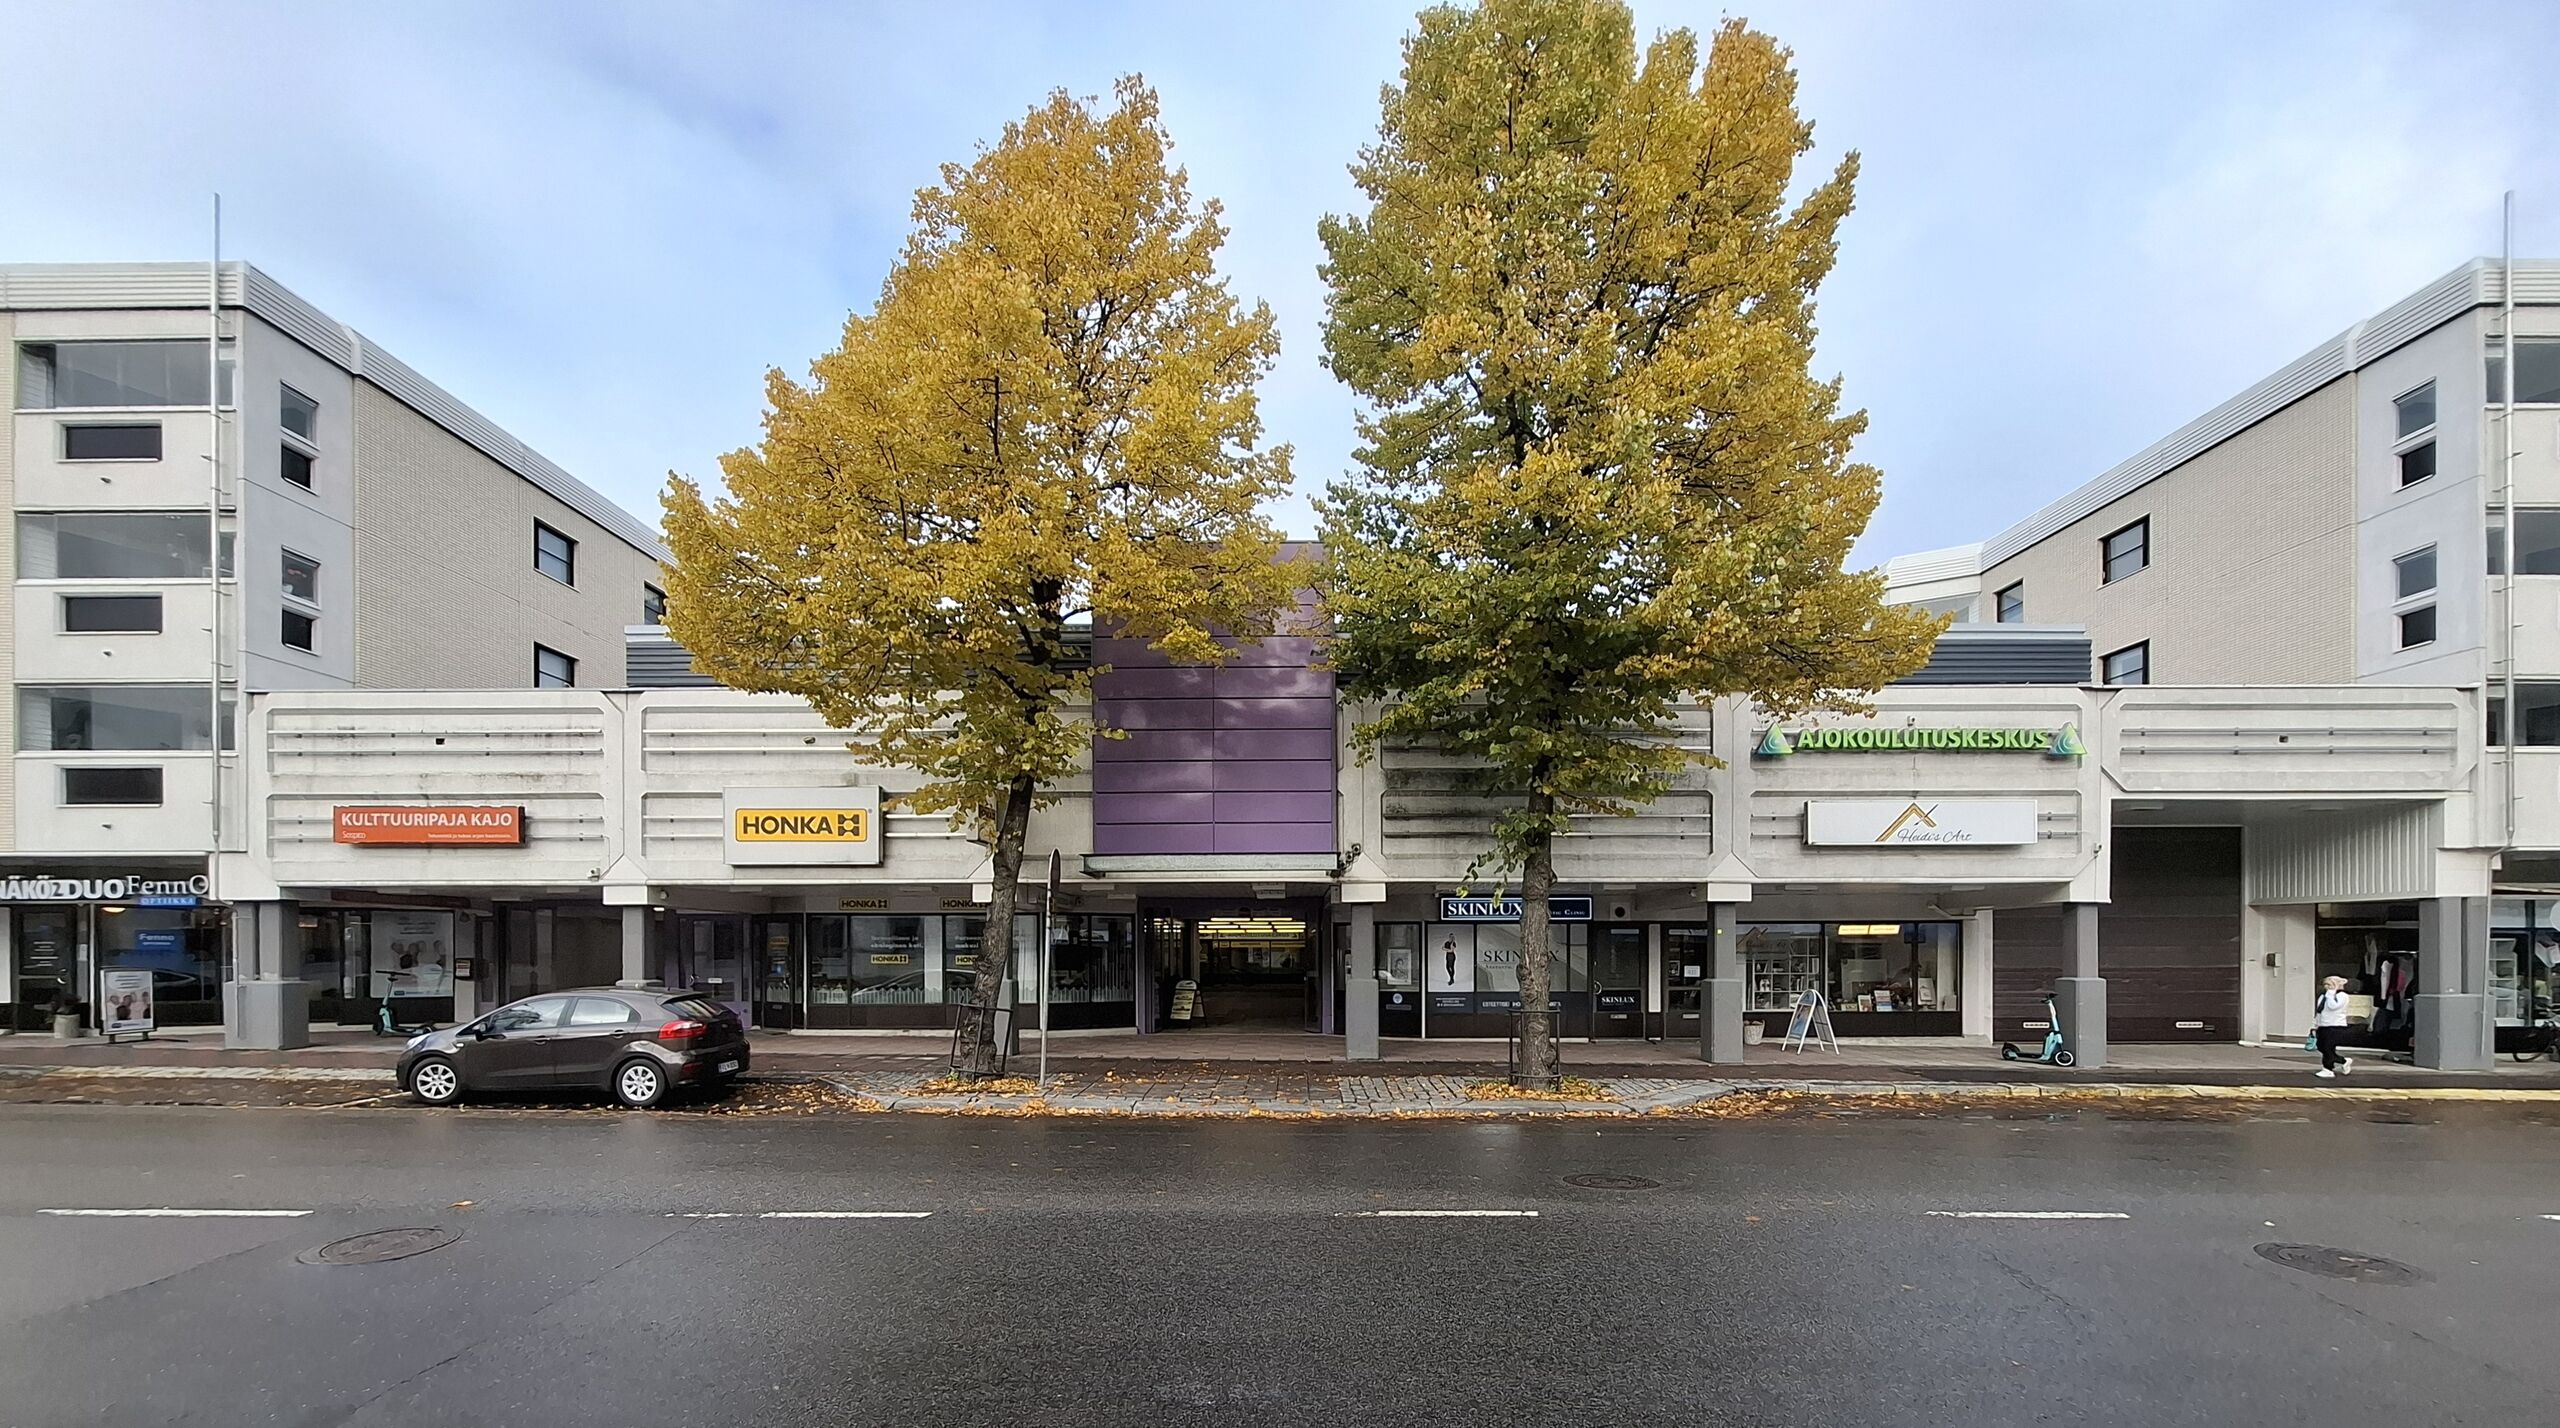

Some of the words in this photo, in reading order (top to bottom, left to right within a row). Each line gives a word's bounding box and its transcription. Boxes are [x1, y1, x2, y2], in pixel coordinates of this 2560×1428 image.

[1797, 728, 2050, 750] AJOKOULUTUSKESKUS
[341, 812, 467, 827] KULTTUURIPAJA
[471, 812, 513, 827] KAJO
[743, 815, 833, 835] HONKA
[1942, 831, 1973, 842] Art
[841, 900, 877, 908] HONKA
[1448, 902, 1523, 916] SKINLUX
[1484, 950, 1560, 962] SKINX
[1601, 996, 1636, 1004] SKINLUX
